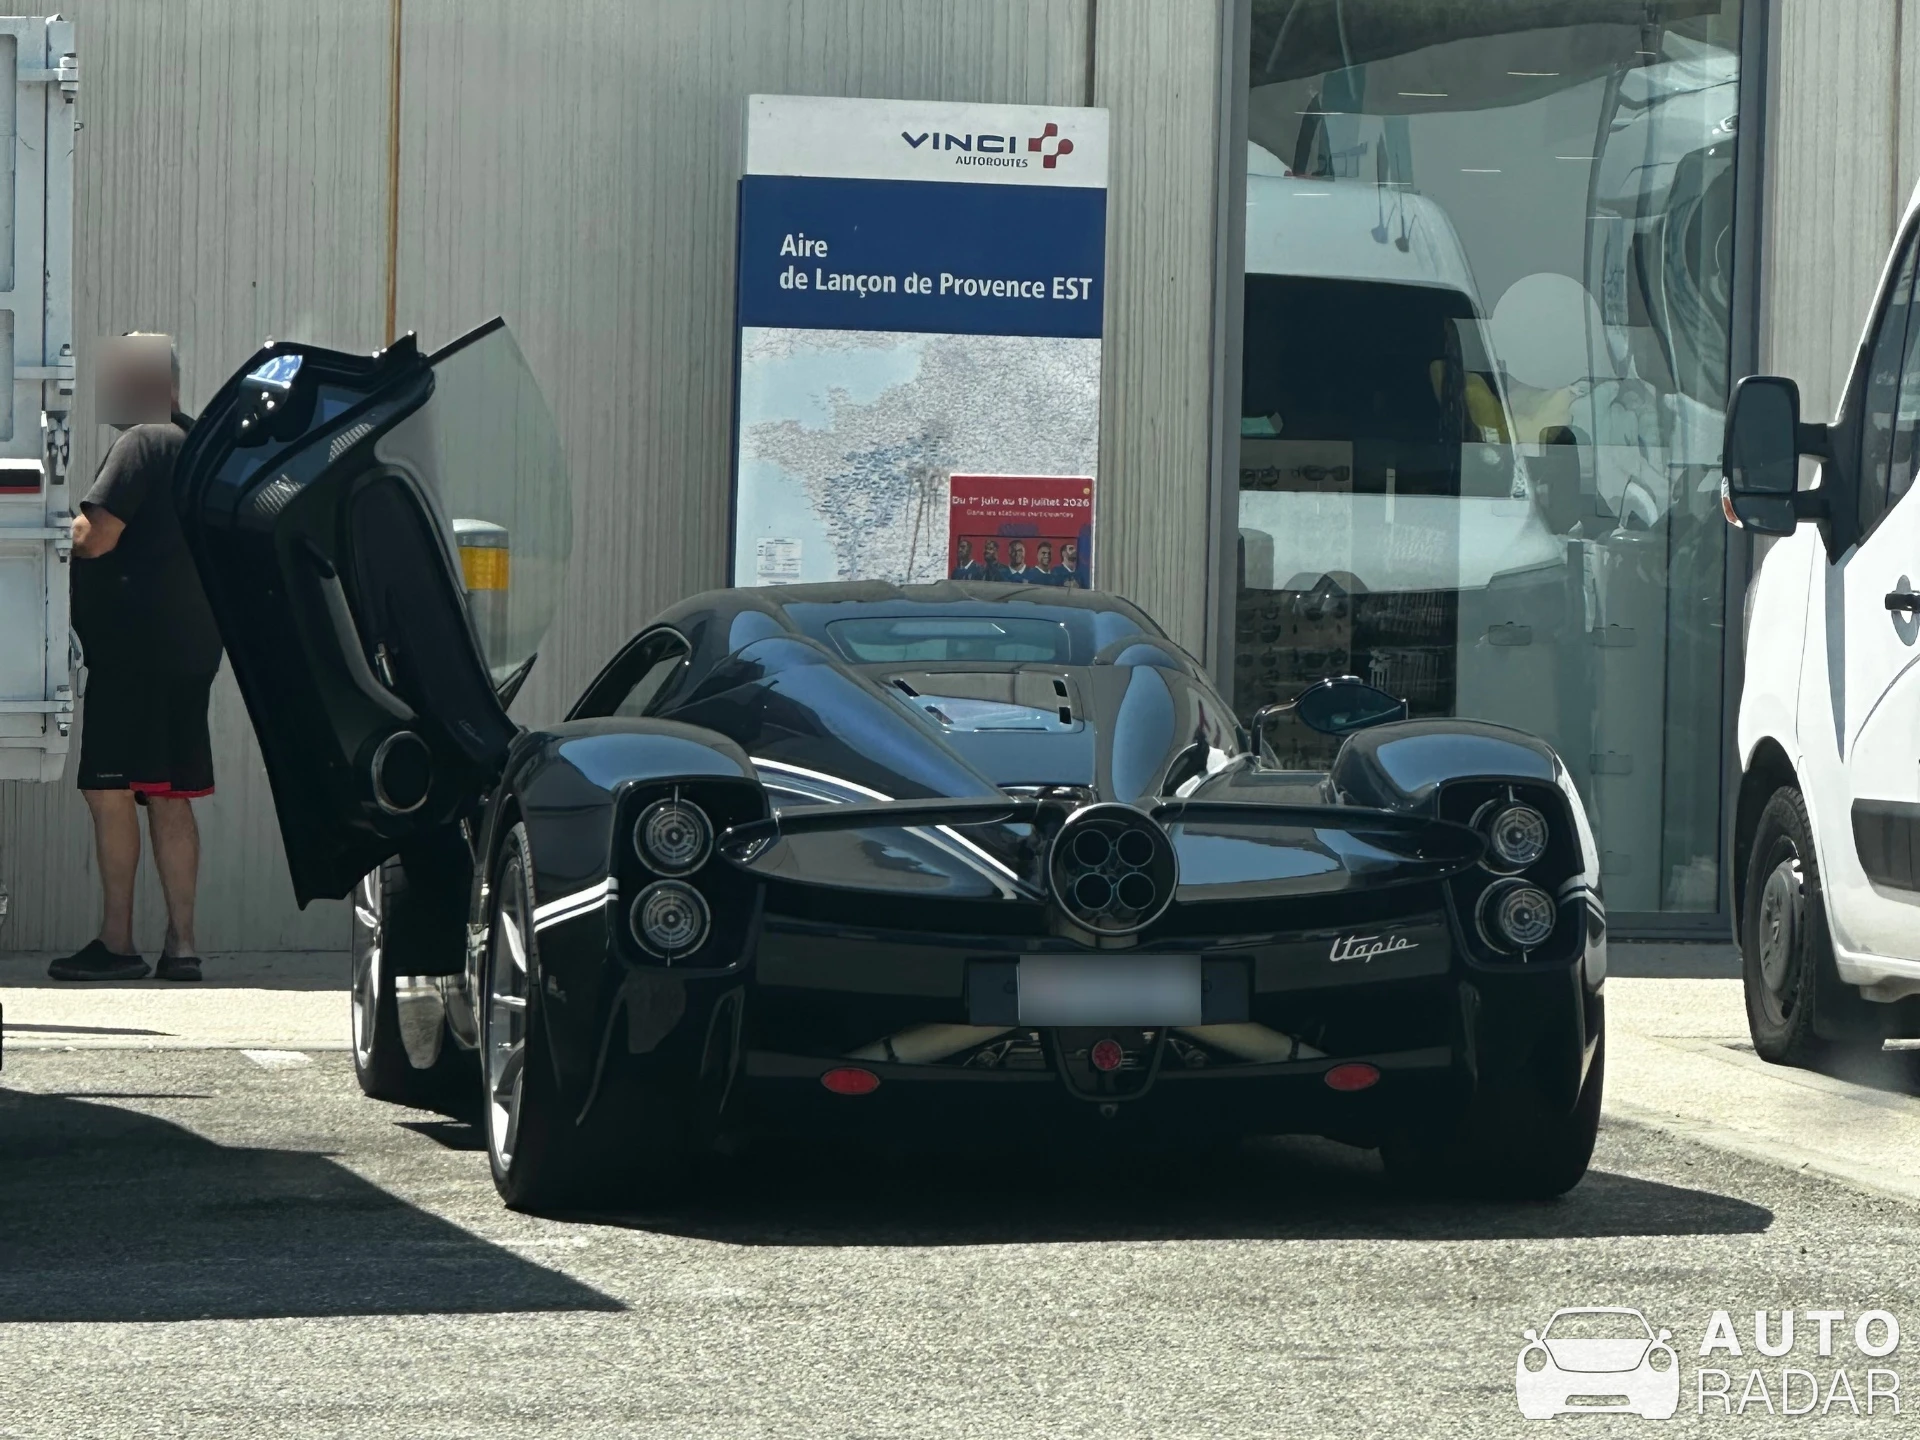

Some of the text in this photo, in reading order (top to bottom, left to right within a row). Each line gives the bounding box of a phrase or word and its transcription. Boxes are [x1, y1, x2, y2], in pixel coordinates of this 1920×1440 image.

[902, 131, 1016, 154] VINCI
[955, 156, 1028, 168] AUTOROUTES
[780, 233, 828, 258] Aire
[780, 266, 1093, 301] de Lançon de Provence EST
[952, 496, 966, 505] Du
[981, 496, 1000, 507] juin
[1002, 498, 1015, 506] au
[1031, 497, 1060, 508] juillet
[1063, 498, 1090, 508] 2026
[1329, 935, 1419, 963] Utopia
